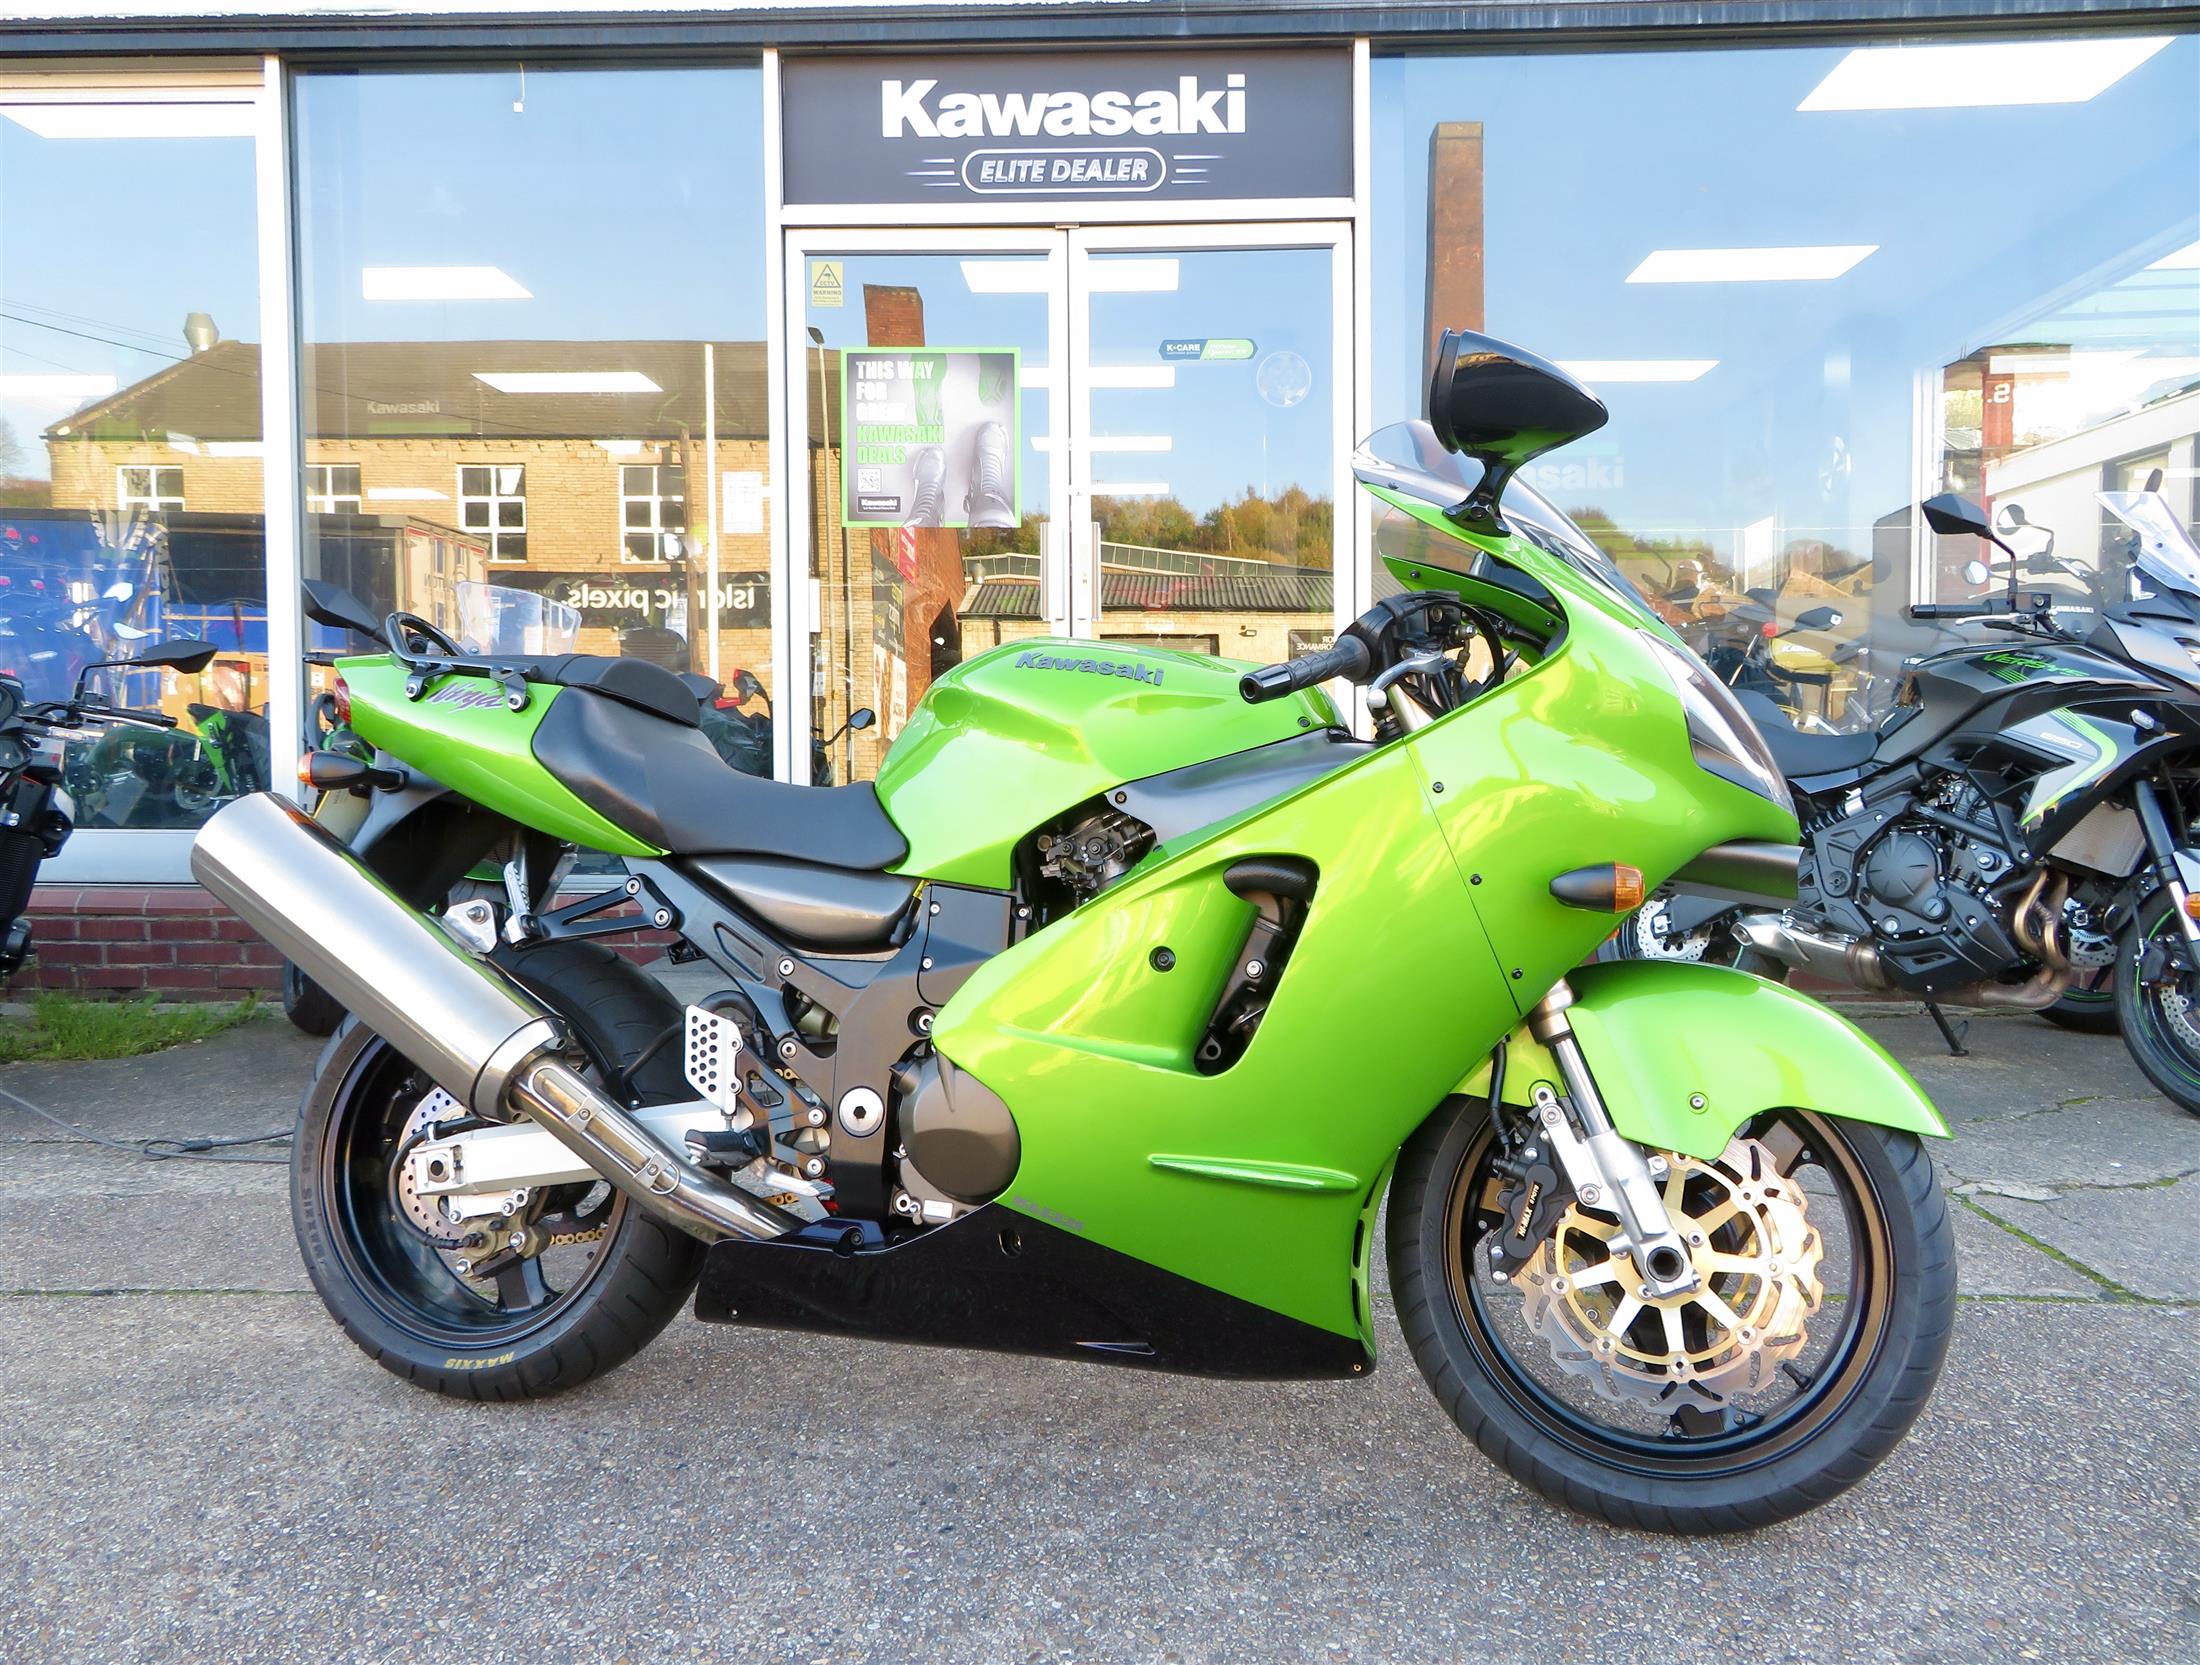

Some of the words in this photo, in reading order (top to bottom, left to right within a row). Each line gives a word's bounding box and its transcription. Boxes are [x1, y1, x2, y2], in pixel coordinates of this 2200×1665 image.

[881, 73, 1246, 138] Kawasaki
[980, 159, 1047, 183] ELITE
[1051, 158, 1149, 182] DEALER
[855, 360, 894, 380] THIS
[897, 360, 935, 380] WAY
[855, 381, 888, 401] FOR
[367, 400, 440, 414] Kawasaki
[856, 424, 945, 443] KAWASAKI
[856, 445, 907, 465] DEALS
[1517, 455, 1625, 489] asaki
[1015, 652, 1165, 686] Kawasaki
[444, 1351, 515, 1370] MAXXIS
